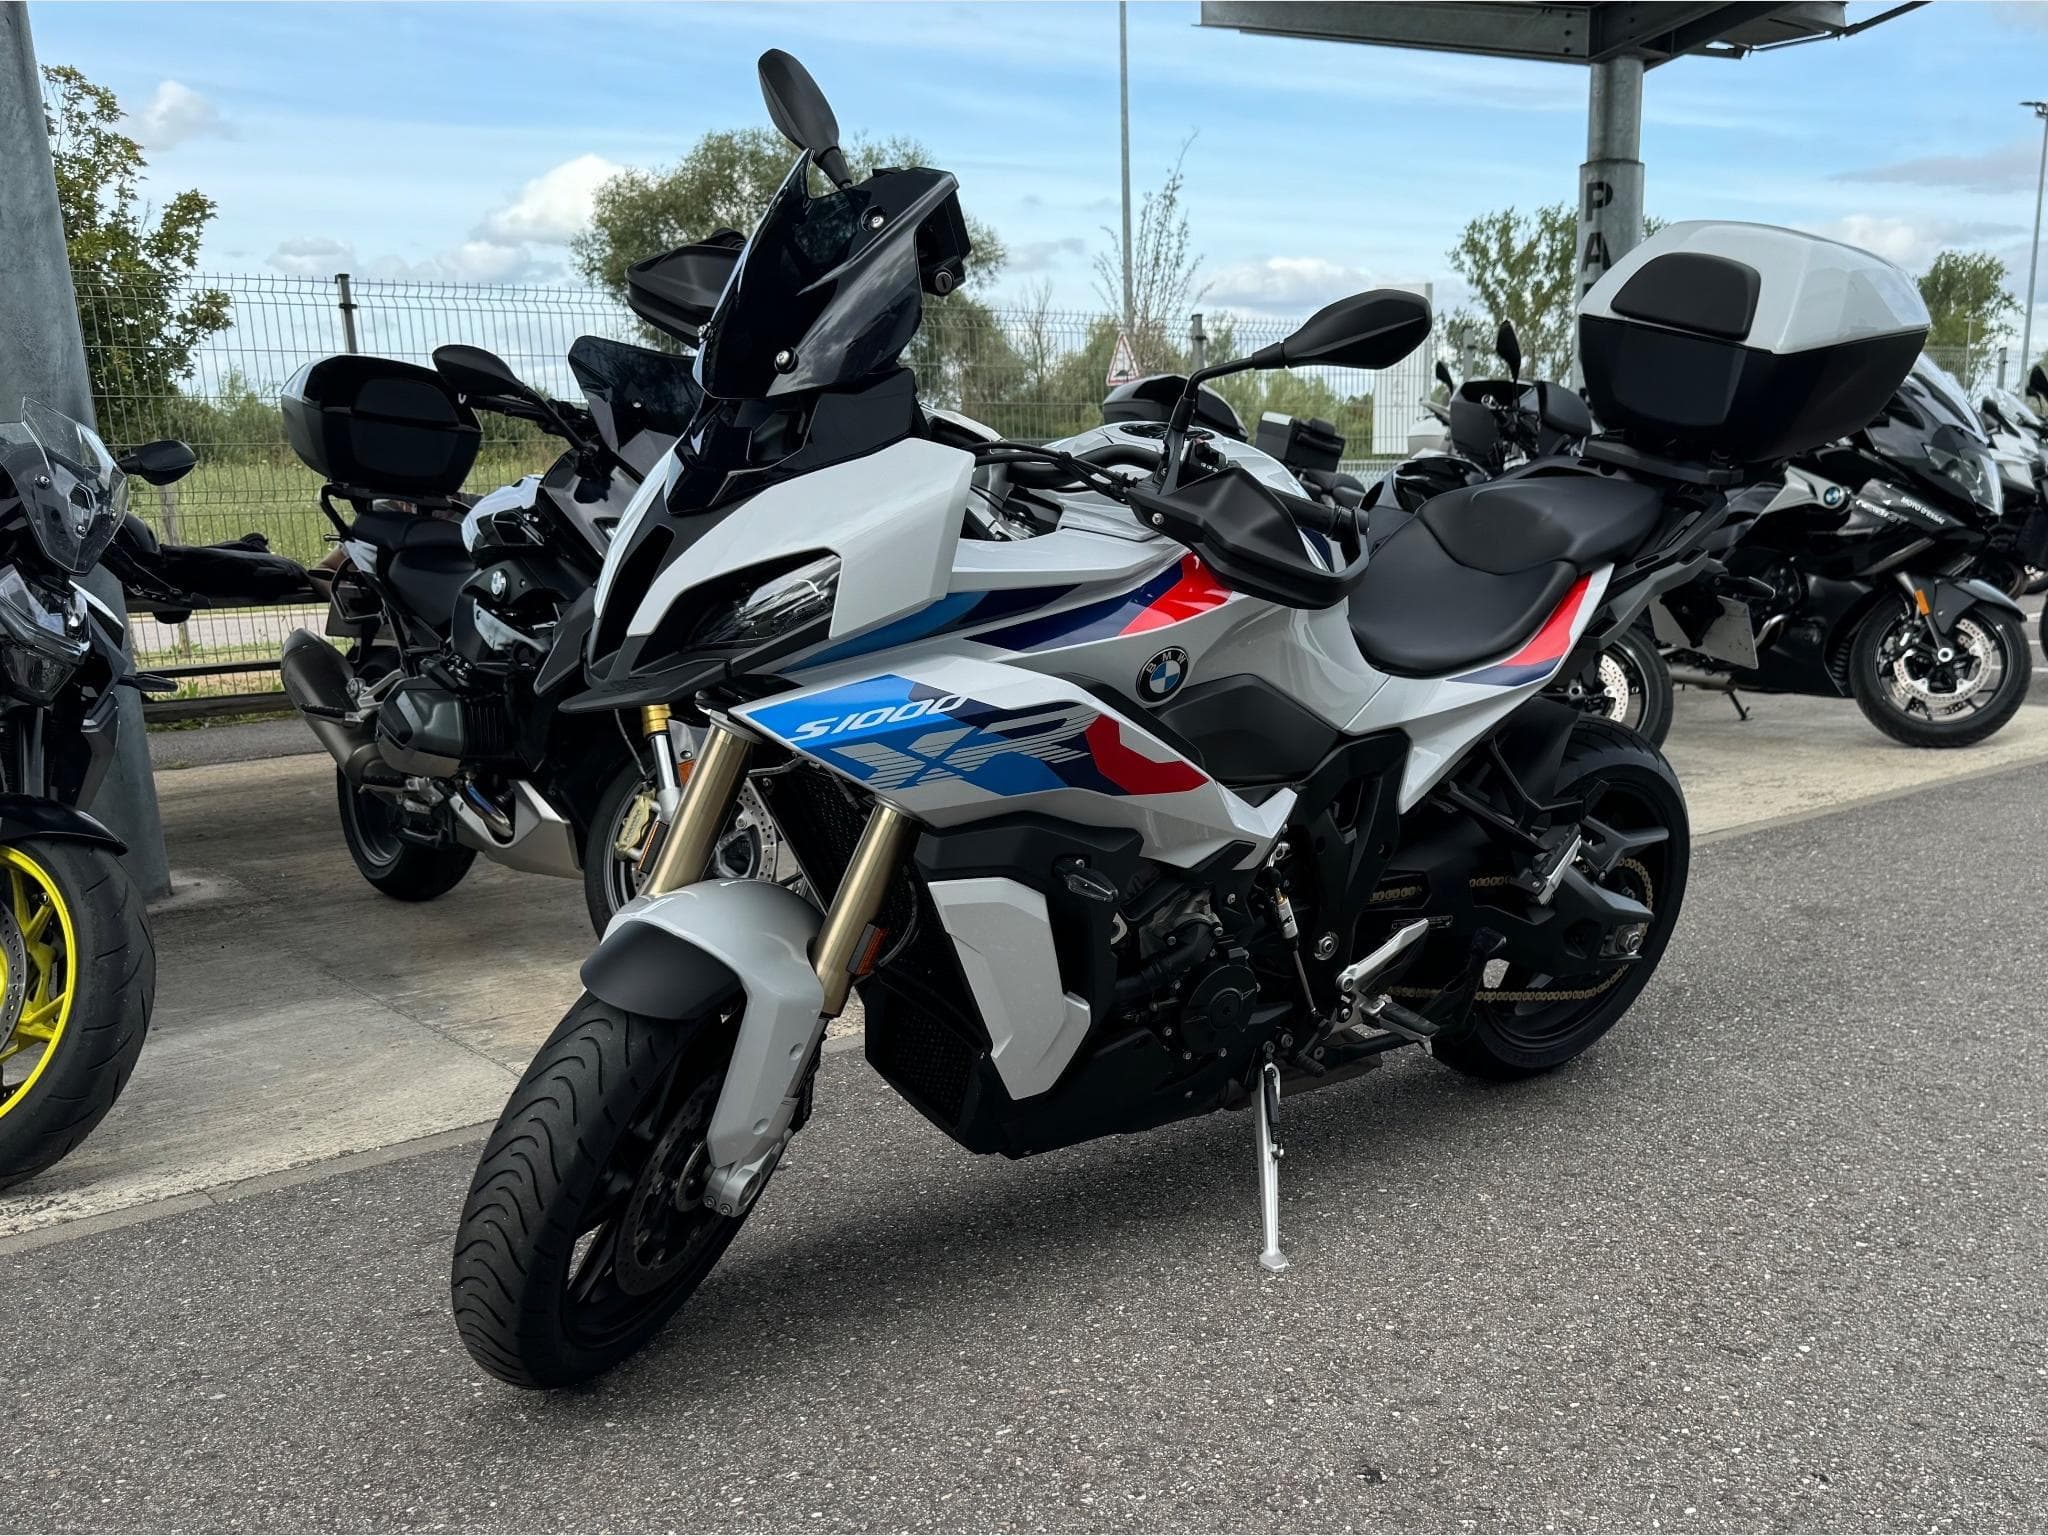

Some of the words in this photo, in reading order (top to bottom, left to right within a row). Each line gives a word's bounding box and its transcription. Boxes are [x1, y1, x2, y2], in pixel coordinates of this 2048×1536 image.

[1581, 182, 1613, 298] PA
[1145, 651, 1187, 674] BMW
[786, 694, 970, 742] S1000
[830, 702, 1100, 790] XR
